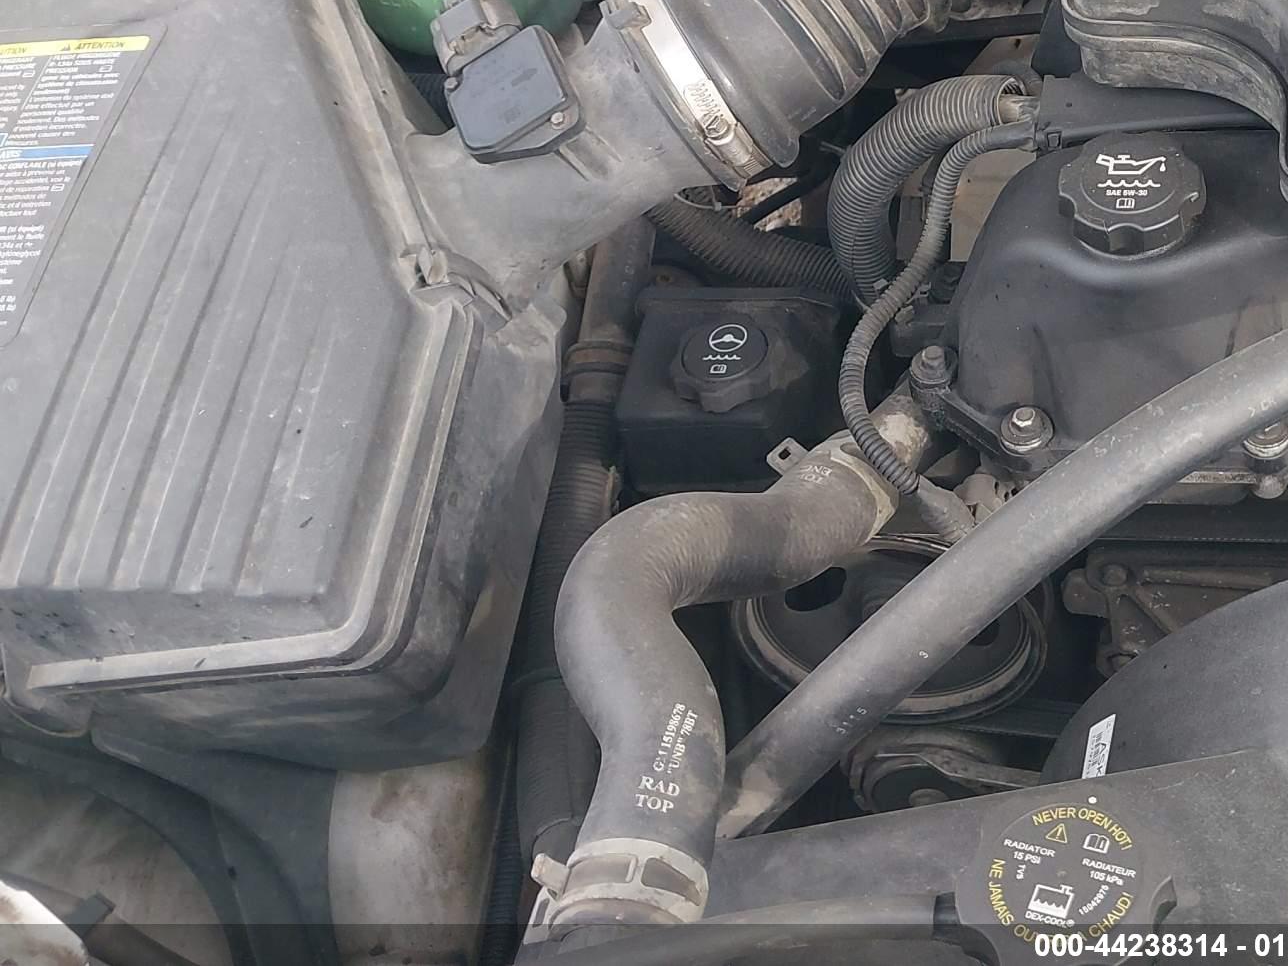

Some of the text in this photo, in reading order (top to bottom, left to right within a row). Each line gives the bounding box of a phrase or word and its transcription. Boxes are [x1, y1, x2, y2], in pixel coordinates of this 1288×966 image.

[75, 42, 125, 50] ATTENTION
[638, 775, 680, 797] RAD
[634, 793, 675, 813] TOP
[1032, 807, 1076, 826] NEVER
[1078, 807, 1113, 830] OPEN
[1003, 838, 1057, 858] RADIATOR
[1013, 850, 1042, 865] 15 PSI
[988, 858, 1007, 880] NE
[1081, 857, 1137, 879] RADIATEUR
[1089, 869, 1124, 886] 105 kPa
[988, 881, 1015, 927] JAMAIS
